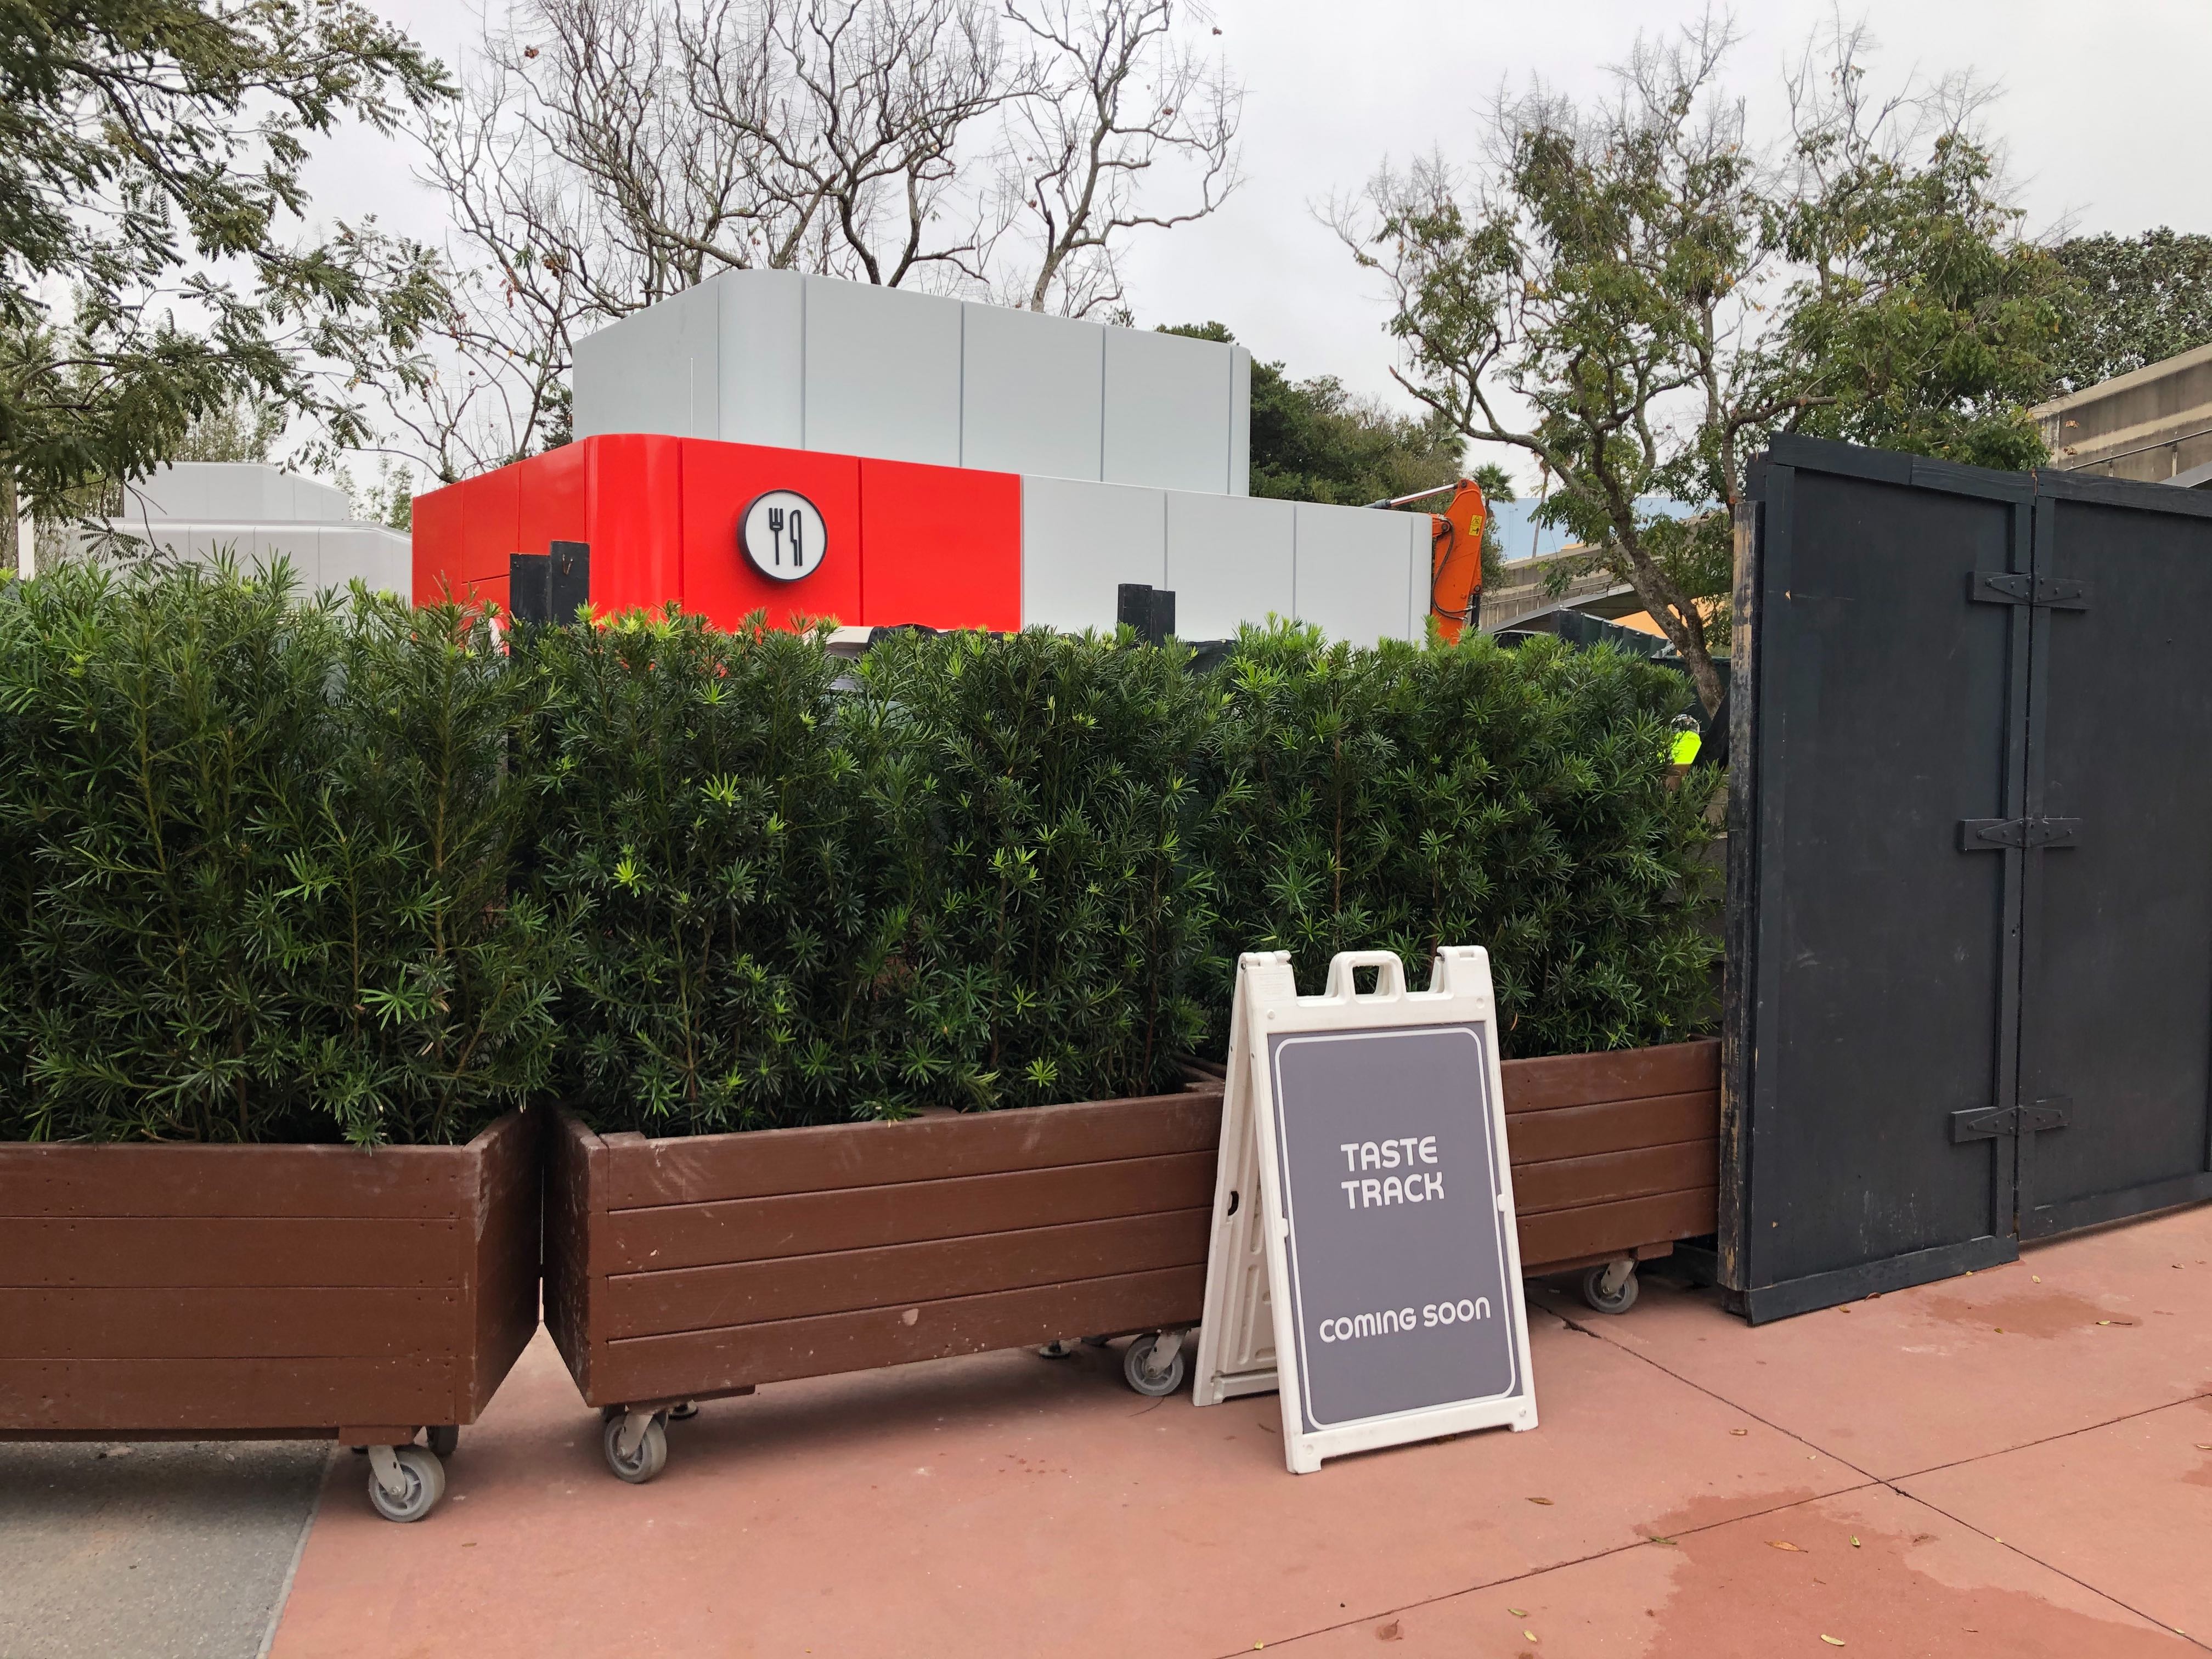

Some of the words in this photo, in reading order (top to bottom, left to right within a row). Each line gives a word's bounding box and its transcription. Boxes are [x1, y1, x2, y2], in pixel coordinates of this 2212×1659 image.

[1340, 1136, 1438, 1172] TASTE
[1341, 1171, 1445, 1210] TRACK
[1319, 1307, 1417, 1343] COMING
[1423, 1296, 1491, 1327] SOON
